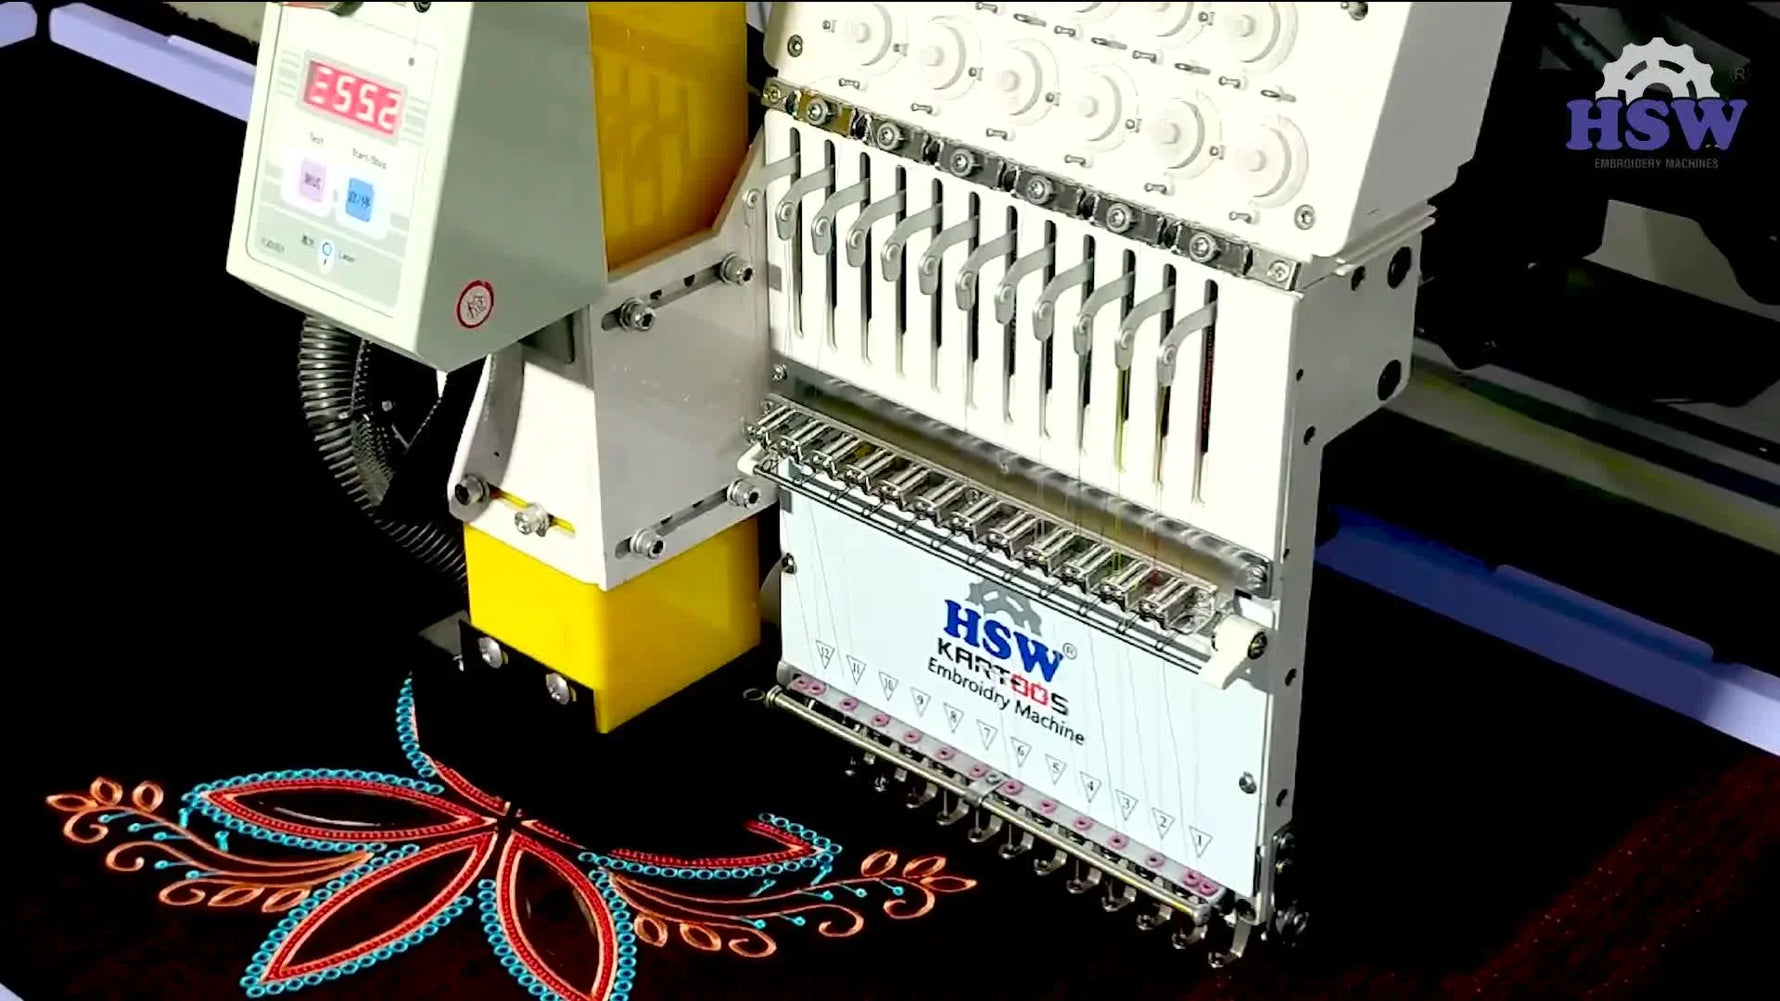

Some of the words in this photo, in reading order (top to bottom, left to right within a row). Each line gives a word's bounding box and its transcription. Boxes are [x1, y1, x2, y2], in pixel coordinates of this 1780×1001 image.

[943, 599, 1064, 683] HSW
[928, 657, 1010, 711] Embroidry
[1015, 700, 1086, 746] Machine
